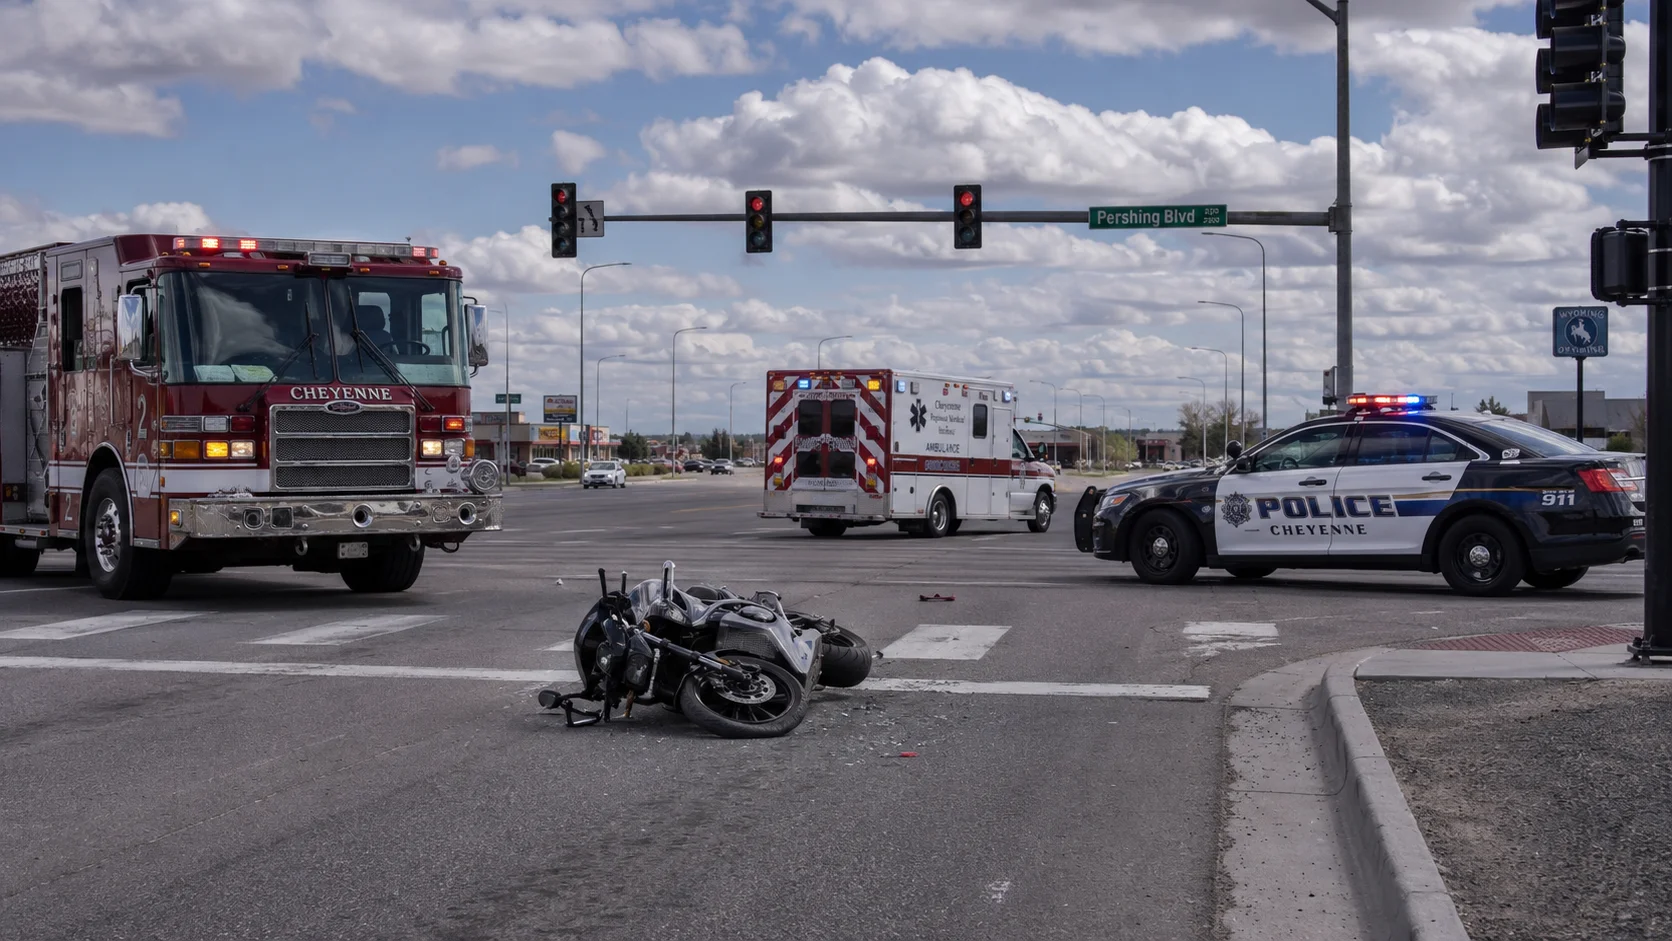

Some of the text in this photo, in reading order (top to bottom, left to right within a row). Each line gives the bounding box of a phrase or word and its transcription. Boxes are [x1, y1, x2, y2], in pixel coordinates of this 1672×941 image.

[1097, 209, 1160, 227] Pershing
[1164, 209, 1195, 223] Blvd
[1558, 309, 1605, 319] WYOMING
[290, 386, 393, 401] CHEYENNE
[137, 393, 148, 440] 2
[64, 493, 73, 522] 2
[1255, 494, 1397, 519] POLICE
[1541, 494, 1575, 506] 911
[1270, 523, 1368, 536] CHEYENNE
